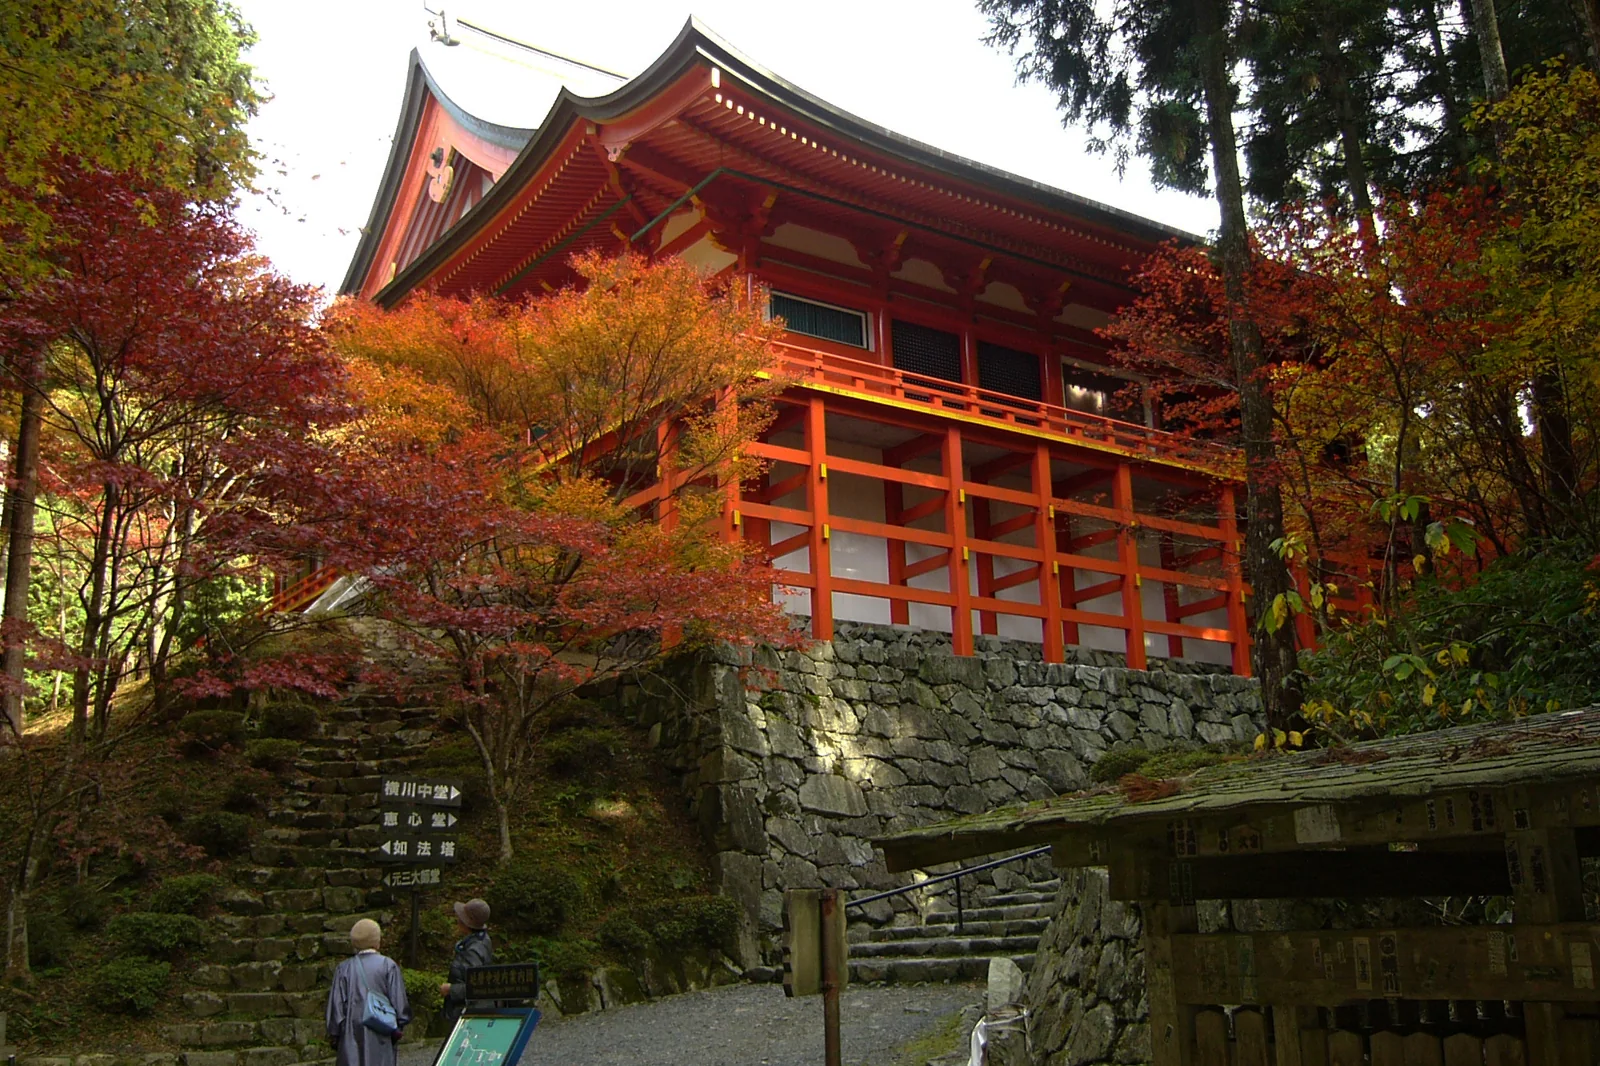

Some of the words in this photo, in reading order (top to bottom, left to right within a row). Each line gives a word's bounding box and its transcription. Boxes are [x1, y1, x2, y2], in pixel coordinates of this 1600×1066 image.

[385, 780, 448, 799] 横川中堂
[384, 811, 446, 827] 恵心堂
[393, 840, 455, 857] 如法塔
[392, 868, 440, 886] 元三大師堂
